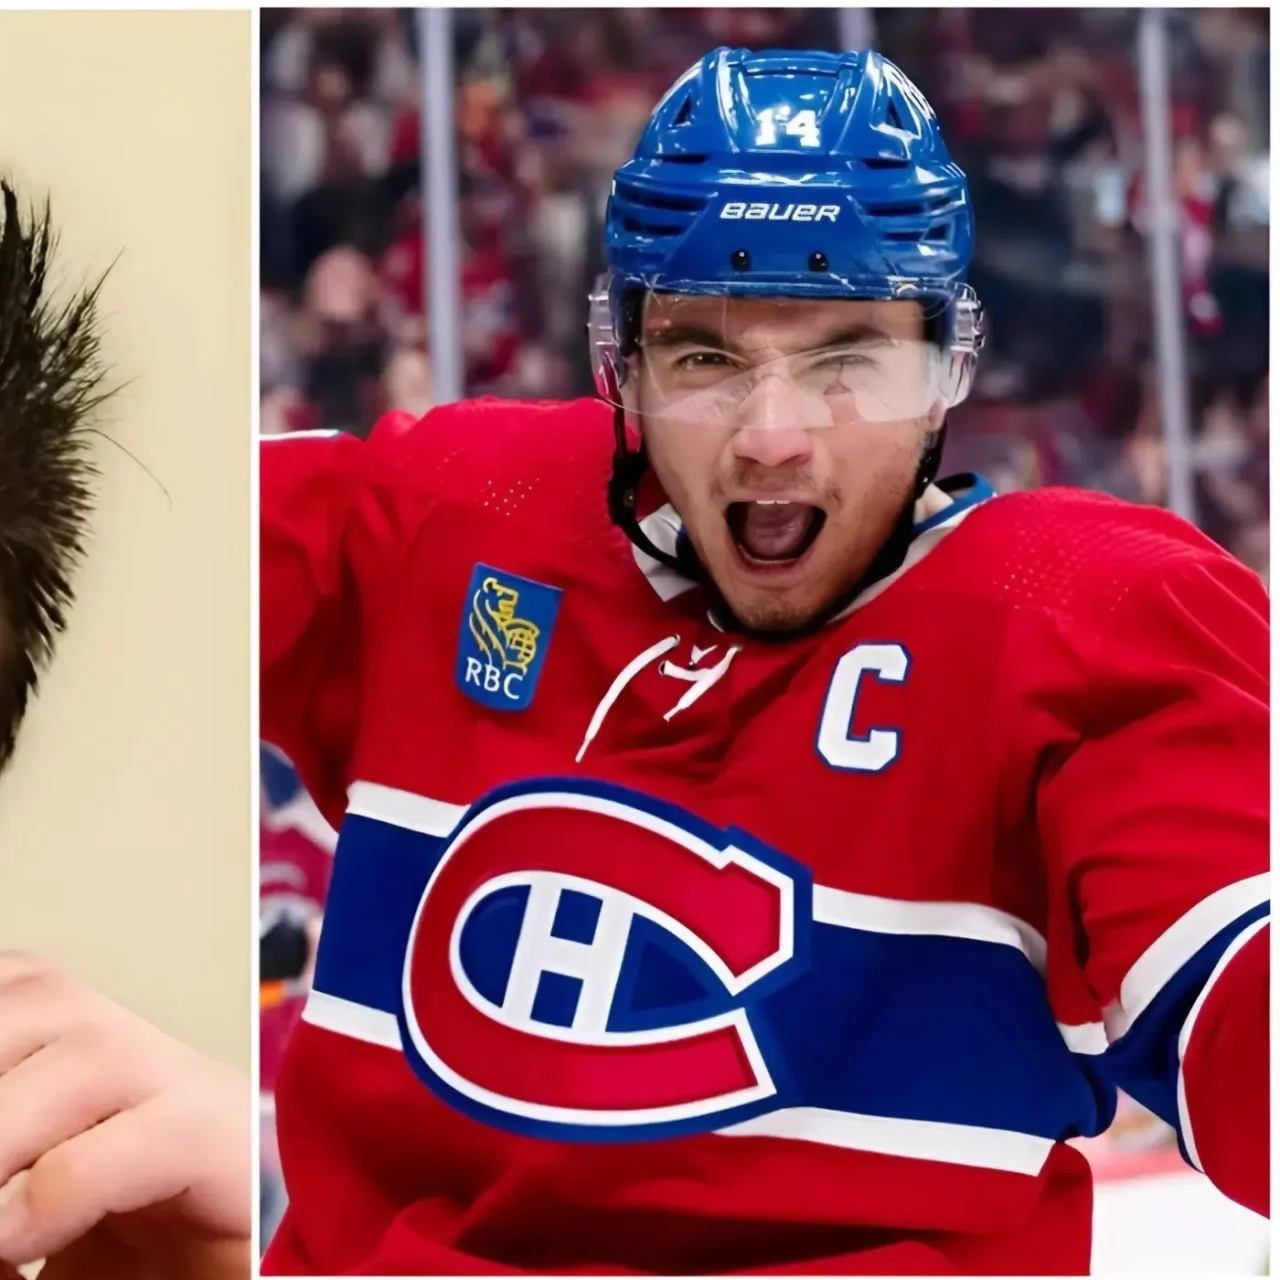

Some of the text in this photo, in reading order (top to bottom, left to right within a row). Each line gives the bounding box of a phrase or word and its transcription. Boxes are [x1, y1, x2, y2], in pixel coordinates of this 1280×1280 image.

[754, 107, 821, 148] 14
[719, 201, 841, 222] BAUER
[464, 655, 524, 700] RBC
[817, 641, 911, 775] C
